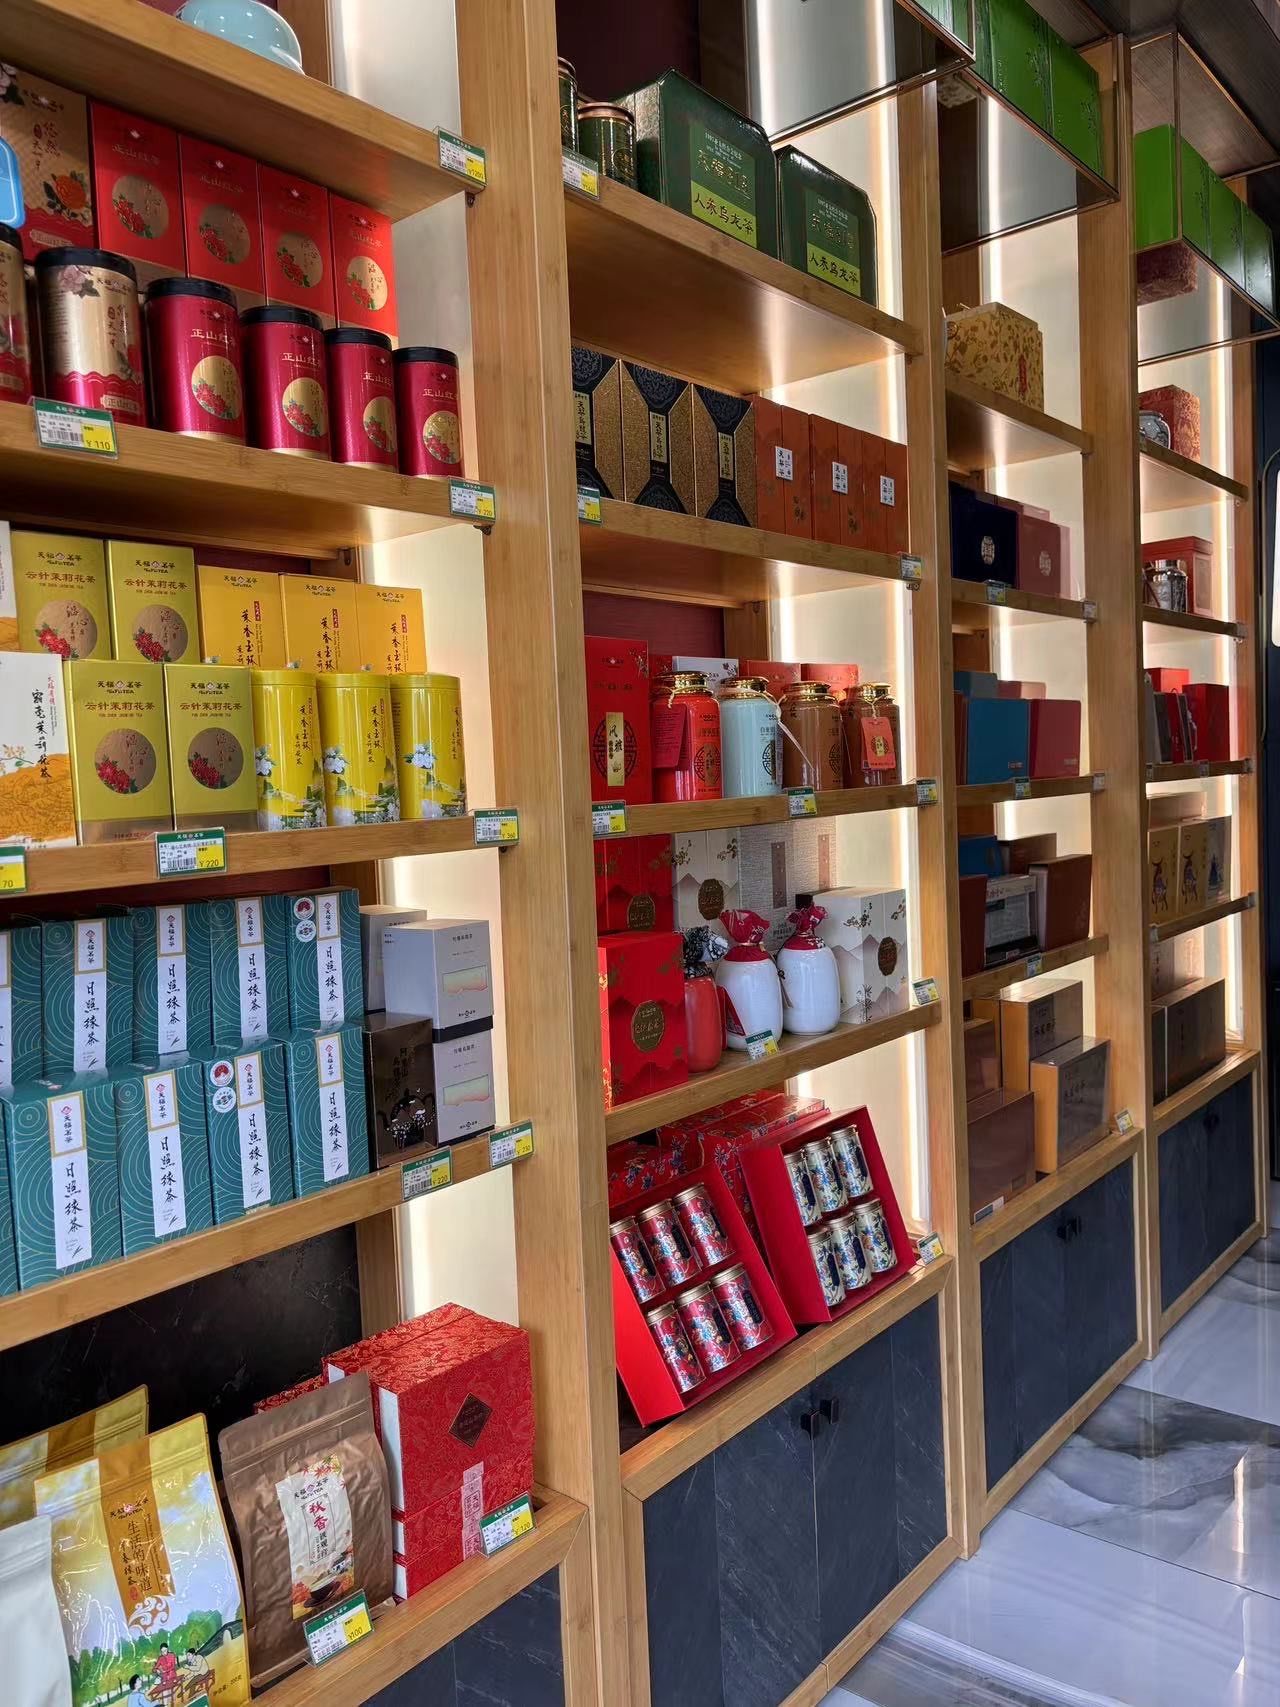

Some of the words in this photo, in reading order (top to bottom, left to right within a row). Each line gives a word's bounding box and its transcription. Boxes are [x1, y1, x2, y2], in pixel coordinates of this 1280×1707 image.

[84, 701, 156, 711] 云针茉莉花茶
[179, 702, 243, 711] 云针茉莉花茶
[309, 1501, 328, 1531] 秋香
[128, 1520, 152, 1592] 生活的味道
